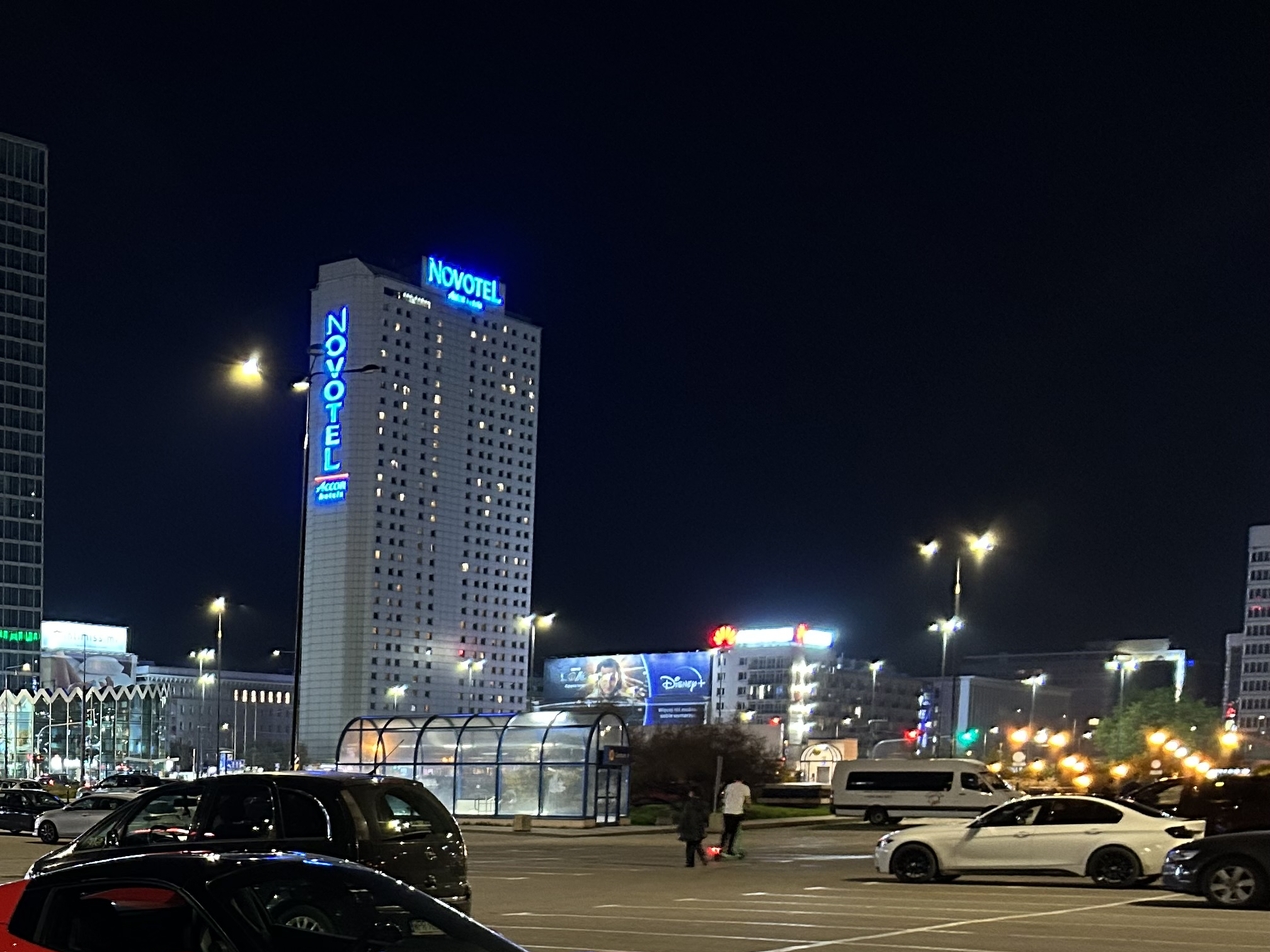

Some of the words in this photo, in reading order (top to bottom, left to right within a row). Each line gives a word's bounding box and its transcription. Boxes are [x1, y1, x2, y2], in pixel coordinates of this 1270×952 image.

[429, 257, 502, 305] NOVOTEL
[324, 306, 347, 472] NOVOTEL
[660, 674, 706, 693] Disney+
